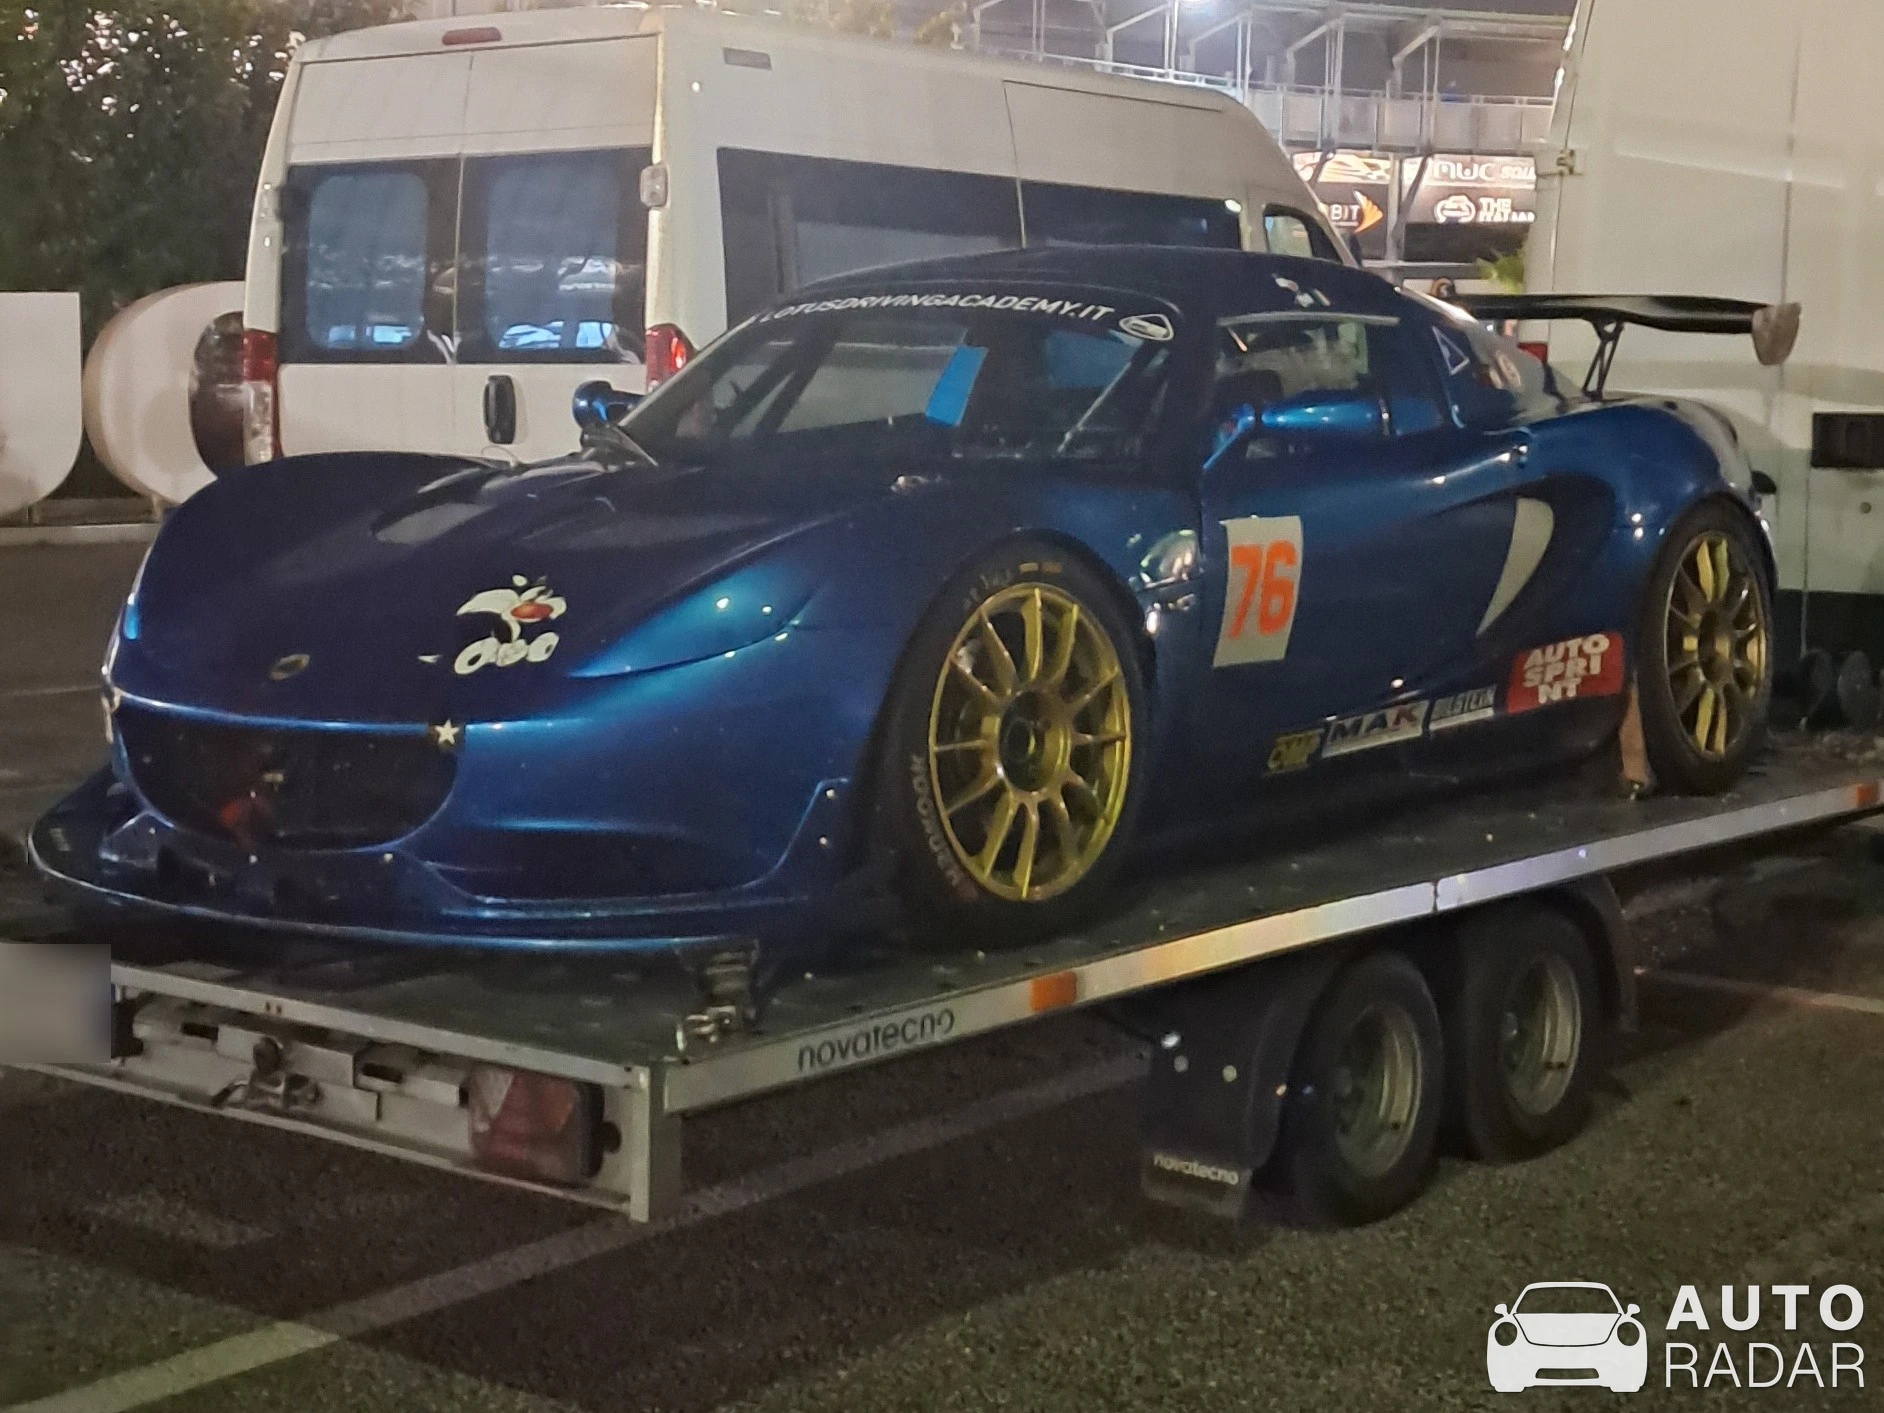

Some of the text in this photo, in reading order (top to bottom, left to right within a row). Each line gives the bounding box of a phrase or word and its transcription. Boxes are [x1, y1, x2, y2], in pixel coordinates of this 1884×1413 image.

[1229, 539, 1297, 639] 76
[1523, 633, 1610, 671] AUTO
[1538, 676, 1582, 704] NT
[797, 1008, 956, 1072] novatecno
[1153, 1154, 1240, 1186] novatecno
